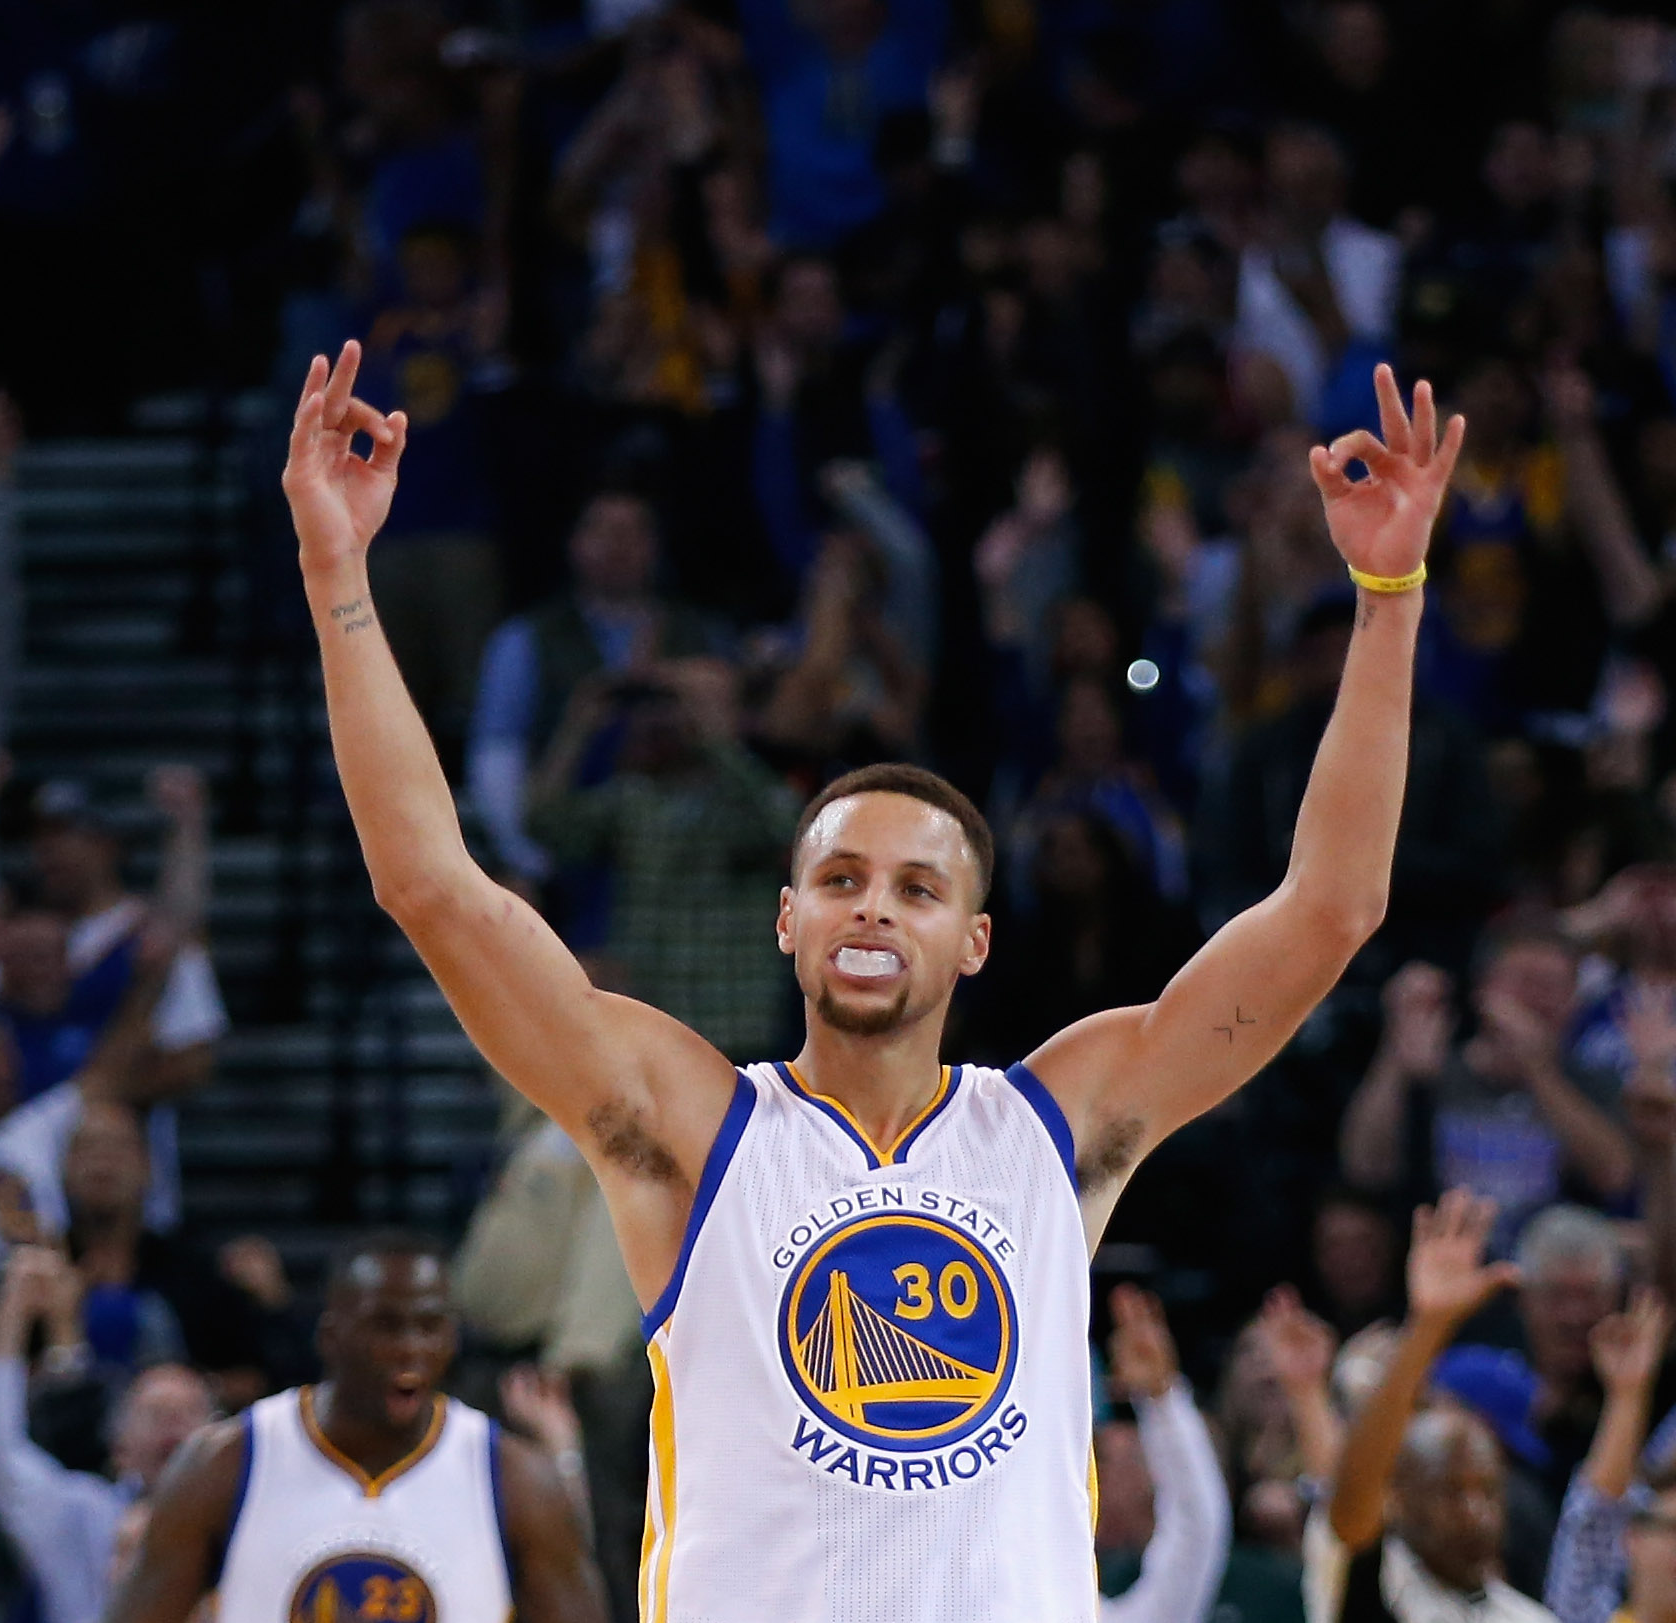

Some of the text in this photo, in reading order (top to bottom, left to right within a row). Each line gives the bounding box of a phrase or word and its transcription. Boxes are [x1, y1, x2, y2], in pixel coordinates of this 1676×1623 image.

[773, 1187, 1016, 1270] GOLDEN STATE
[892, 1260, 980, 1320] 30
[790, 1402, 1029, 1491] WARRIORS
[358, 1575, 423, 1623] 23
